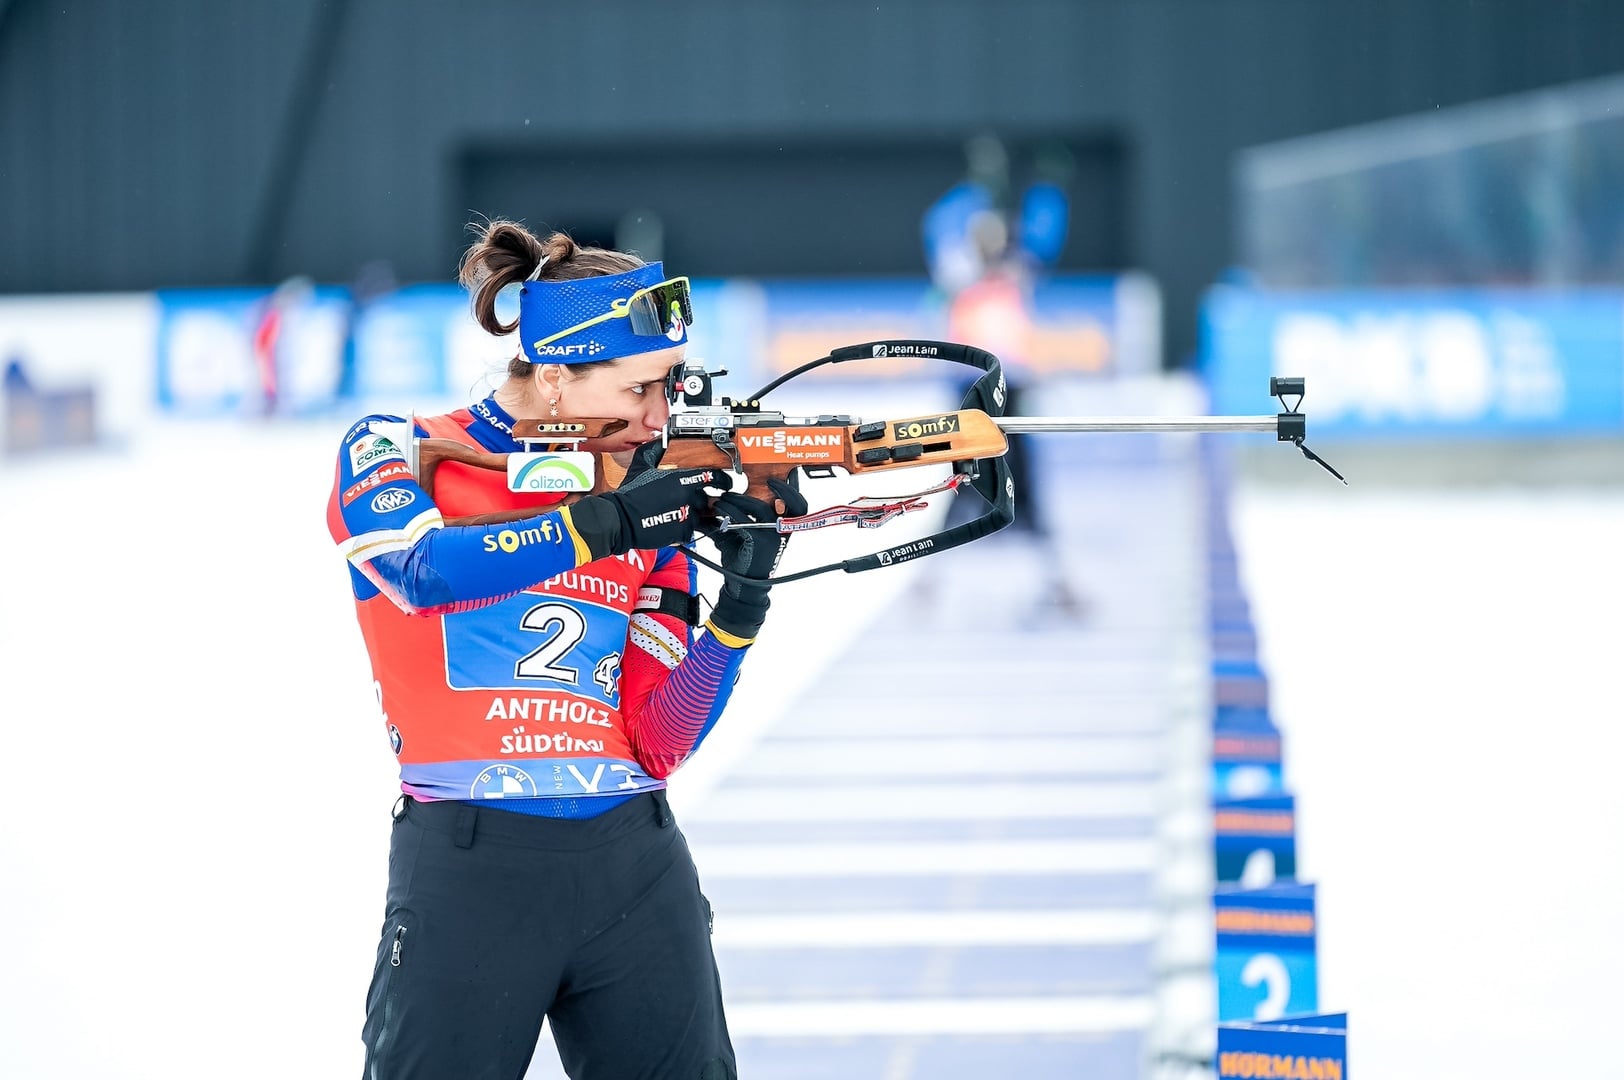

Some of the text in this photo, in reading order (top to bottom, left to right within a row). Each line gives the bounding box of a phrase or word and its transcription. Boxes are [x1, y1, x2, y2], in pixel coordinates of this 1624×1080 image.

[536, 344, 586, 356] CRAFT
[888, 345, 938, 356] Jean Lain
[476, 402, 514, 435] CRAFT
[898, 417, 956, 438] somfy
[741, 430, 841, 454] VIESSMANN
[805, 452, 830, 460] pumps
[529, 475, 574, 488] alizon
[375, 490, 410, 511] RWS
[891, 545, 913, 558] Jean
[515, 602, 586, 685] 2
[594, 653, 620, 697] 4
[485, 697, 613, 728] ANTHOLZ
[555, 765, 563, 789] NEW
